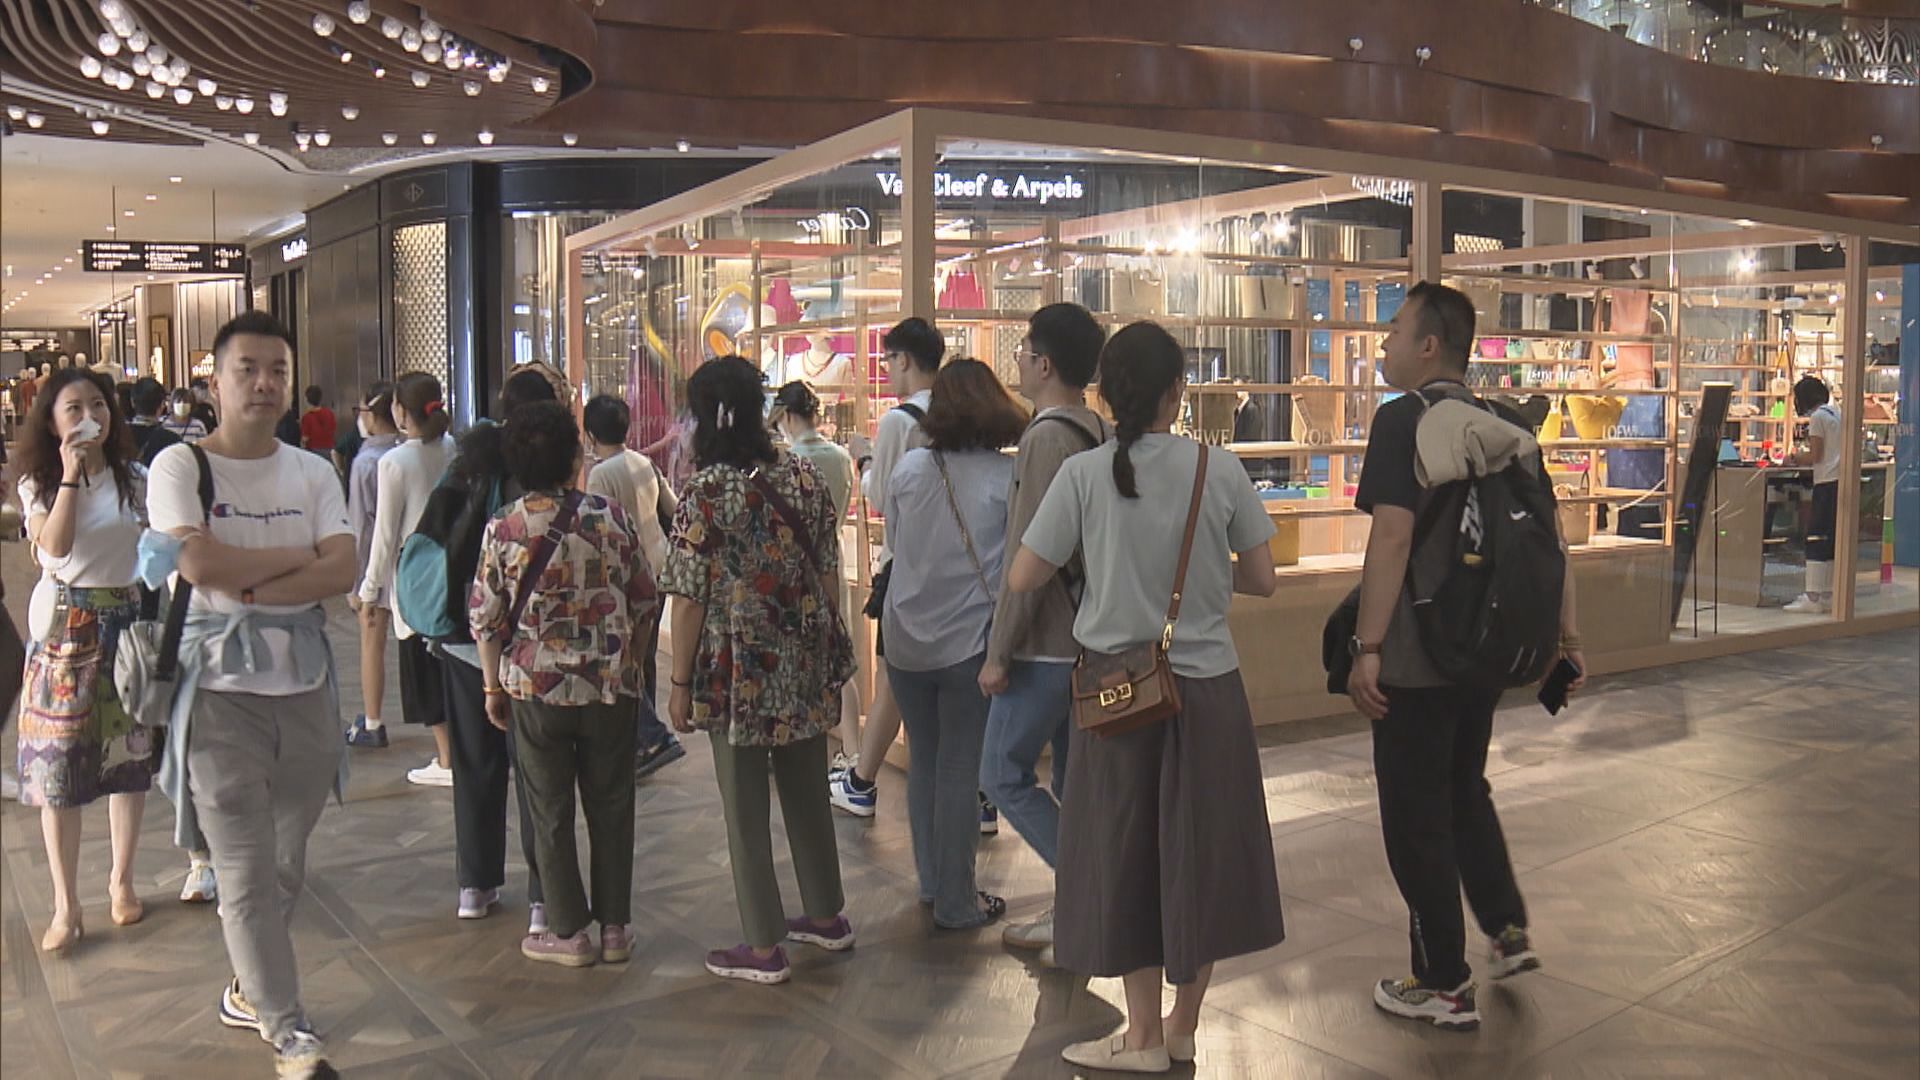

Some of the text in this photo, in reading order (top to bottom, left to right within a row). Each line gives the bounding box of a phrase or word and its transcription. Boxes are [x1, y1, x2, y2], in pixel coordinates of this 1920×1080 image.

[876, 173, 903, 196] Va
[991, 178, 1009, 198] &
[1012, 174, 1083, 204] Arpels
[211, 502, 303, 525] Champion
